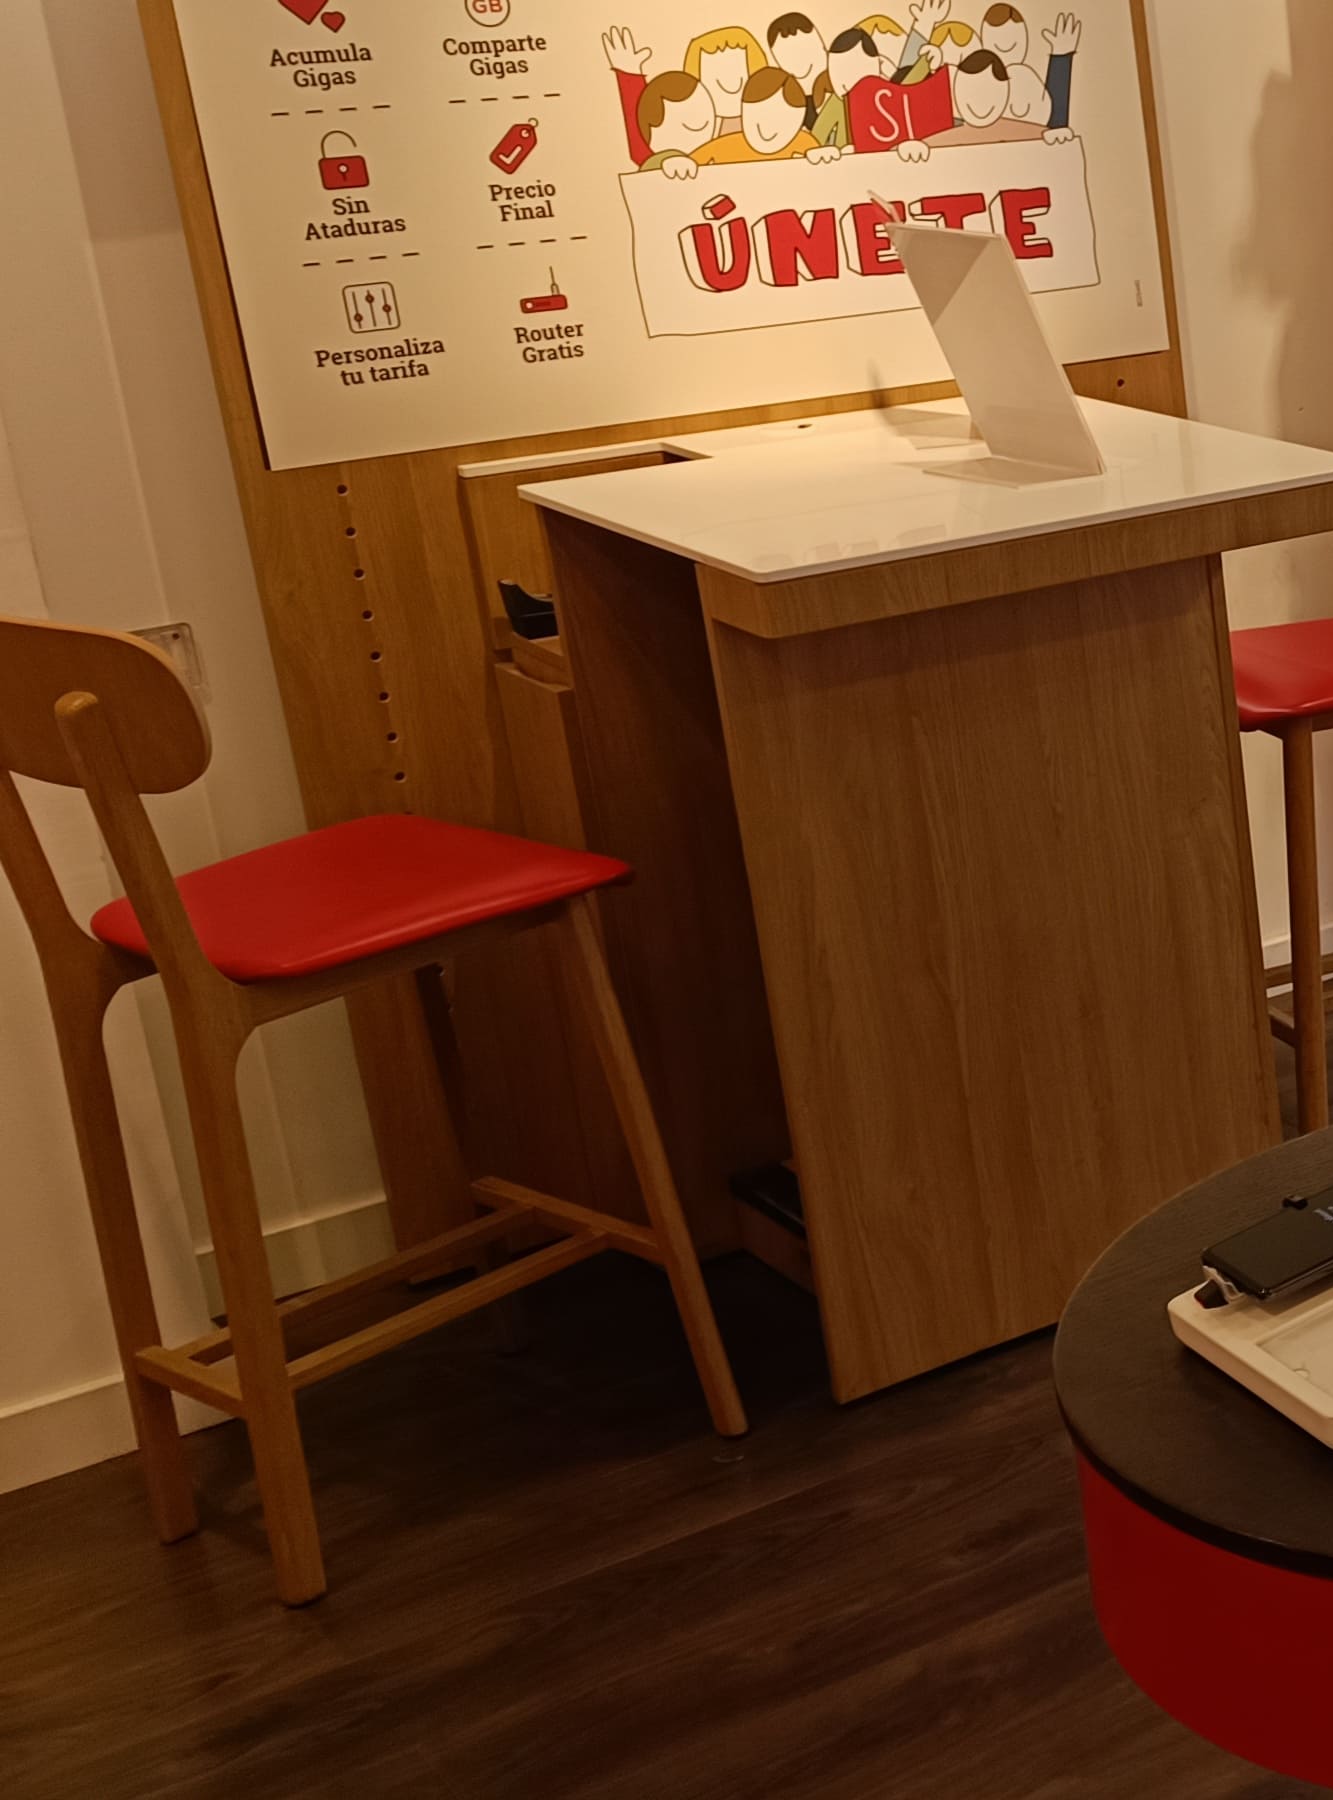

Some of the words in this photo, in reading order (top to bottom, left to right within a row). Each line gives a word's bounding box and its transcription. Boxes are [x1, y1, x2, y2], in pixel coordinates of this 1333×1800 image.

[270, 43, 372, 67] Acumula
[443, 34, 547, 57] Comparte
[293, 68, 357, 91] Gigas
[470, 57, 529, 79] Gigas
[488, 179, 556, 202] Precio
[331, 196, 370, 216] Sin
[500, 199, 554, 222] Final
[304, 216, 406, 241] Ataduras
[513, 320, 585, 345] Router
[315, 337, 445, 368] Personaliza
[522, 341, 585, 365] Gratis
[340, 367, 366, 386] tu
[370, 358, 430, 384] tarifa
